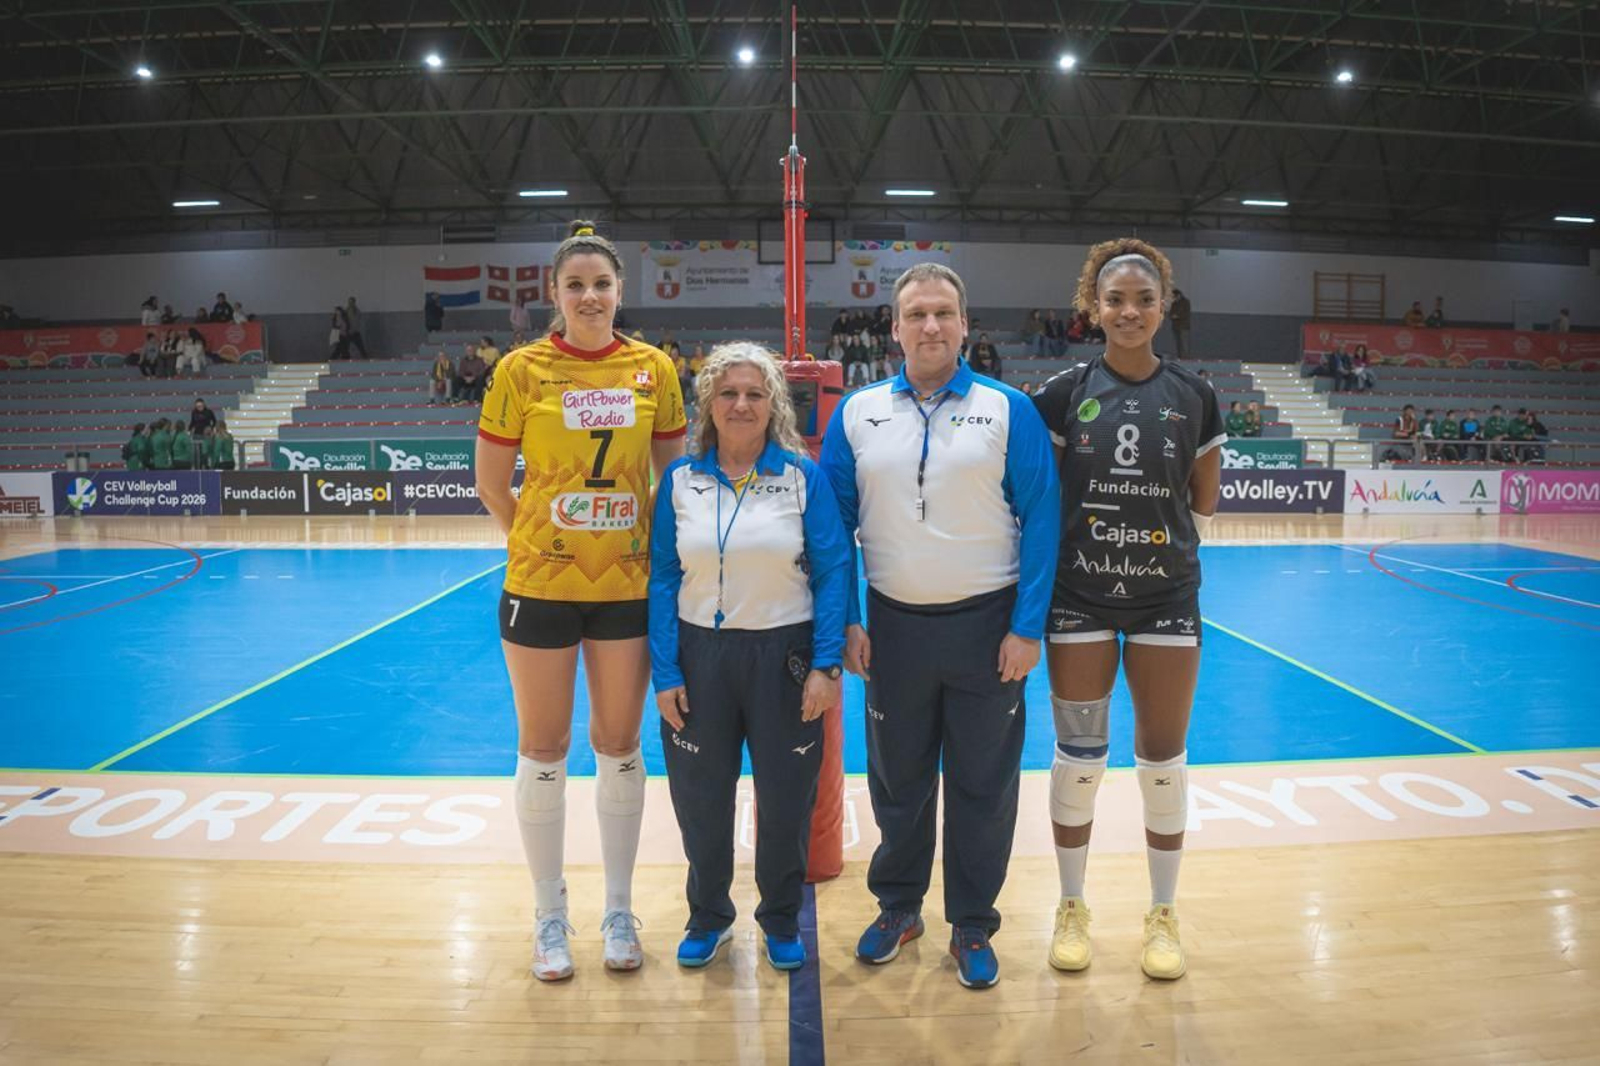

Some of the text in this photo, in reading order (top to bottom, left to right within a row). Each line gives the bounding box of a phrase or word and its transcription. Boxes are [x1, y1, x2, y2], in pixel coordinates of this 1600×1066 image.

[564, 390, 633, 409] GirlPower
[577, 409, 626, 428] Radio
[967, 416, 993, 425] CEV
[424, 451, 470, 462] Diputación
[589, 429, 614, 479] 7
[1114, 423, 1140, 467] 8
[103, 479, 177, 494] CEV Volleyball
[224, 481, 392, 507] Fundación Cajasol
[1089, 479, 1171, 499] Fundación
[1219, 478, 1334, 506] oVolley.TV
[1349, 479, 1446, 505] Andalucía
[104, 493, 207, 508] Challenge Cup 2026
[1089, 519, 1171, 548] Cajasol
[1071, 549, 1169, 579] Andalucía
[509, 599, 521, 628] 7
[680, 740, 700, 754] CEV
